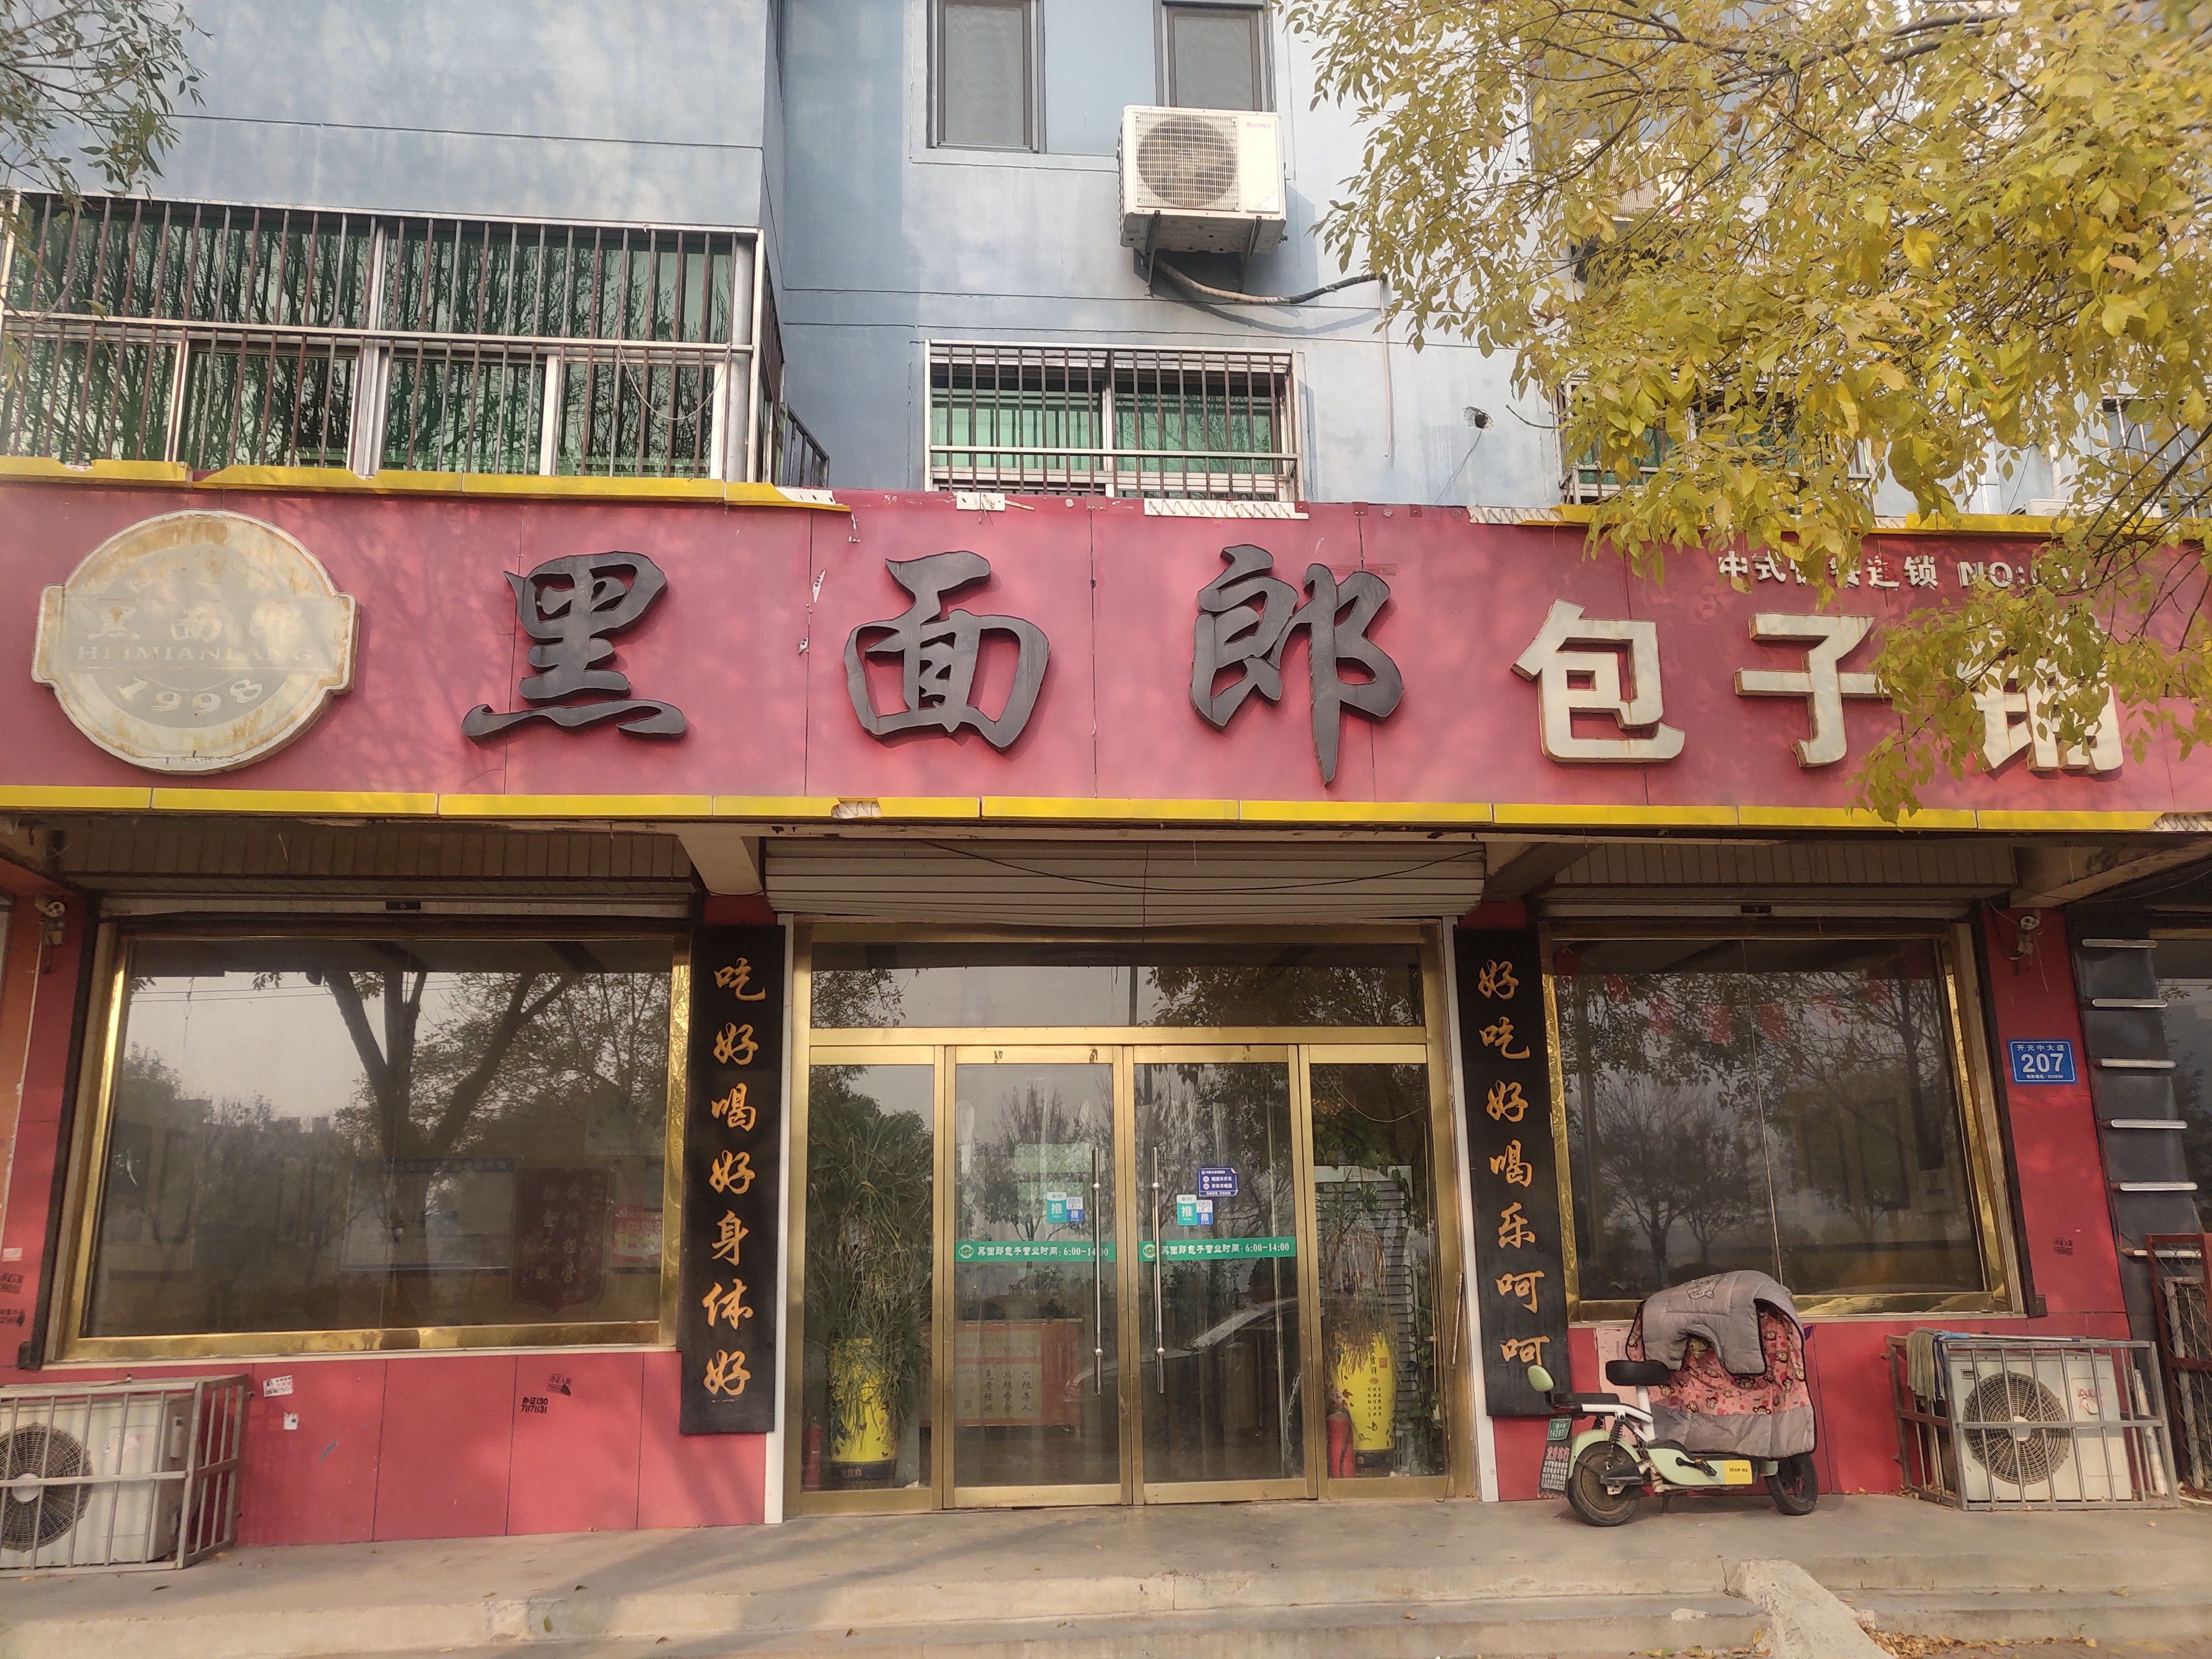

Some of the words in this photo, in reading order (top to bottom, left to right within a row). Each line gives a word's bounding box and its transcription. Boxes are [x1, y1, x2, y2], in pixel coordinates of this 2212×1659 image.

[462, 543, 1403, 787] 黑面郎
[115, 677, 263, 714] 1998
[2021, 1053, 2064, 1073] 207
[1477, 959, 1550, 1367] 好吃好喝乐呵呵
[701, 957, 767, 1397] 吃好喝好身体好
[1051, 1202, 1063, 1215] 推
[1070, 1210, 1080, 1219] 推
[1181, 1205, 1193, 1217] 推
[1200, 1213, 1210, 1222] 推
[977, 1245, 1109, 1257] 黑面郎包子营业时间：6:00-1400
